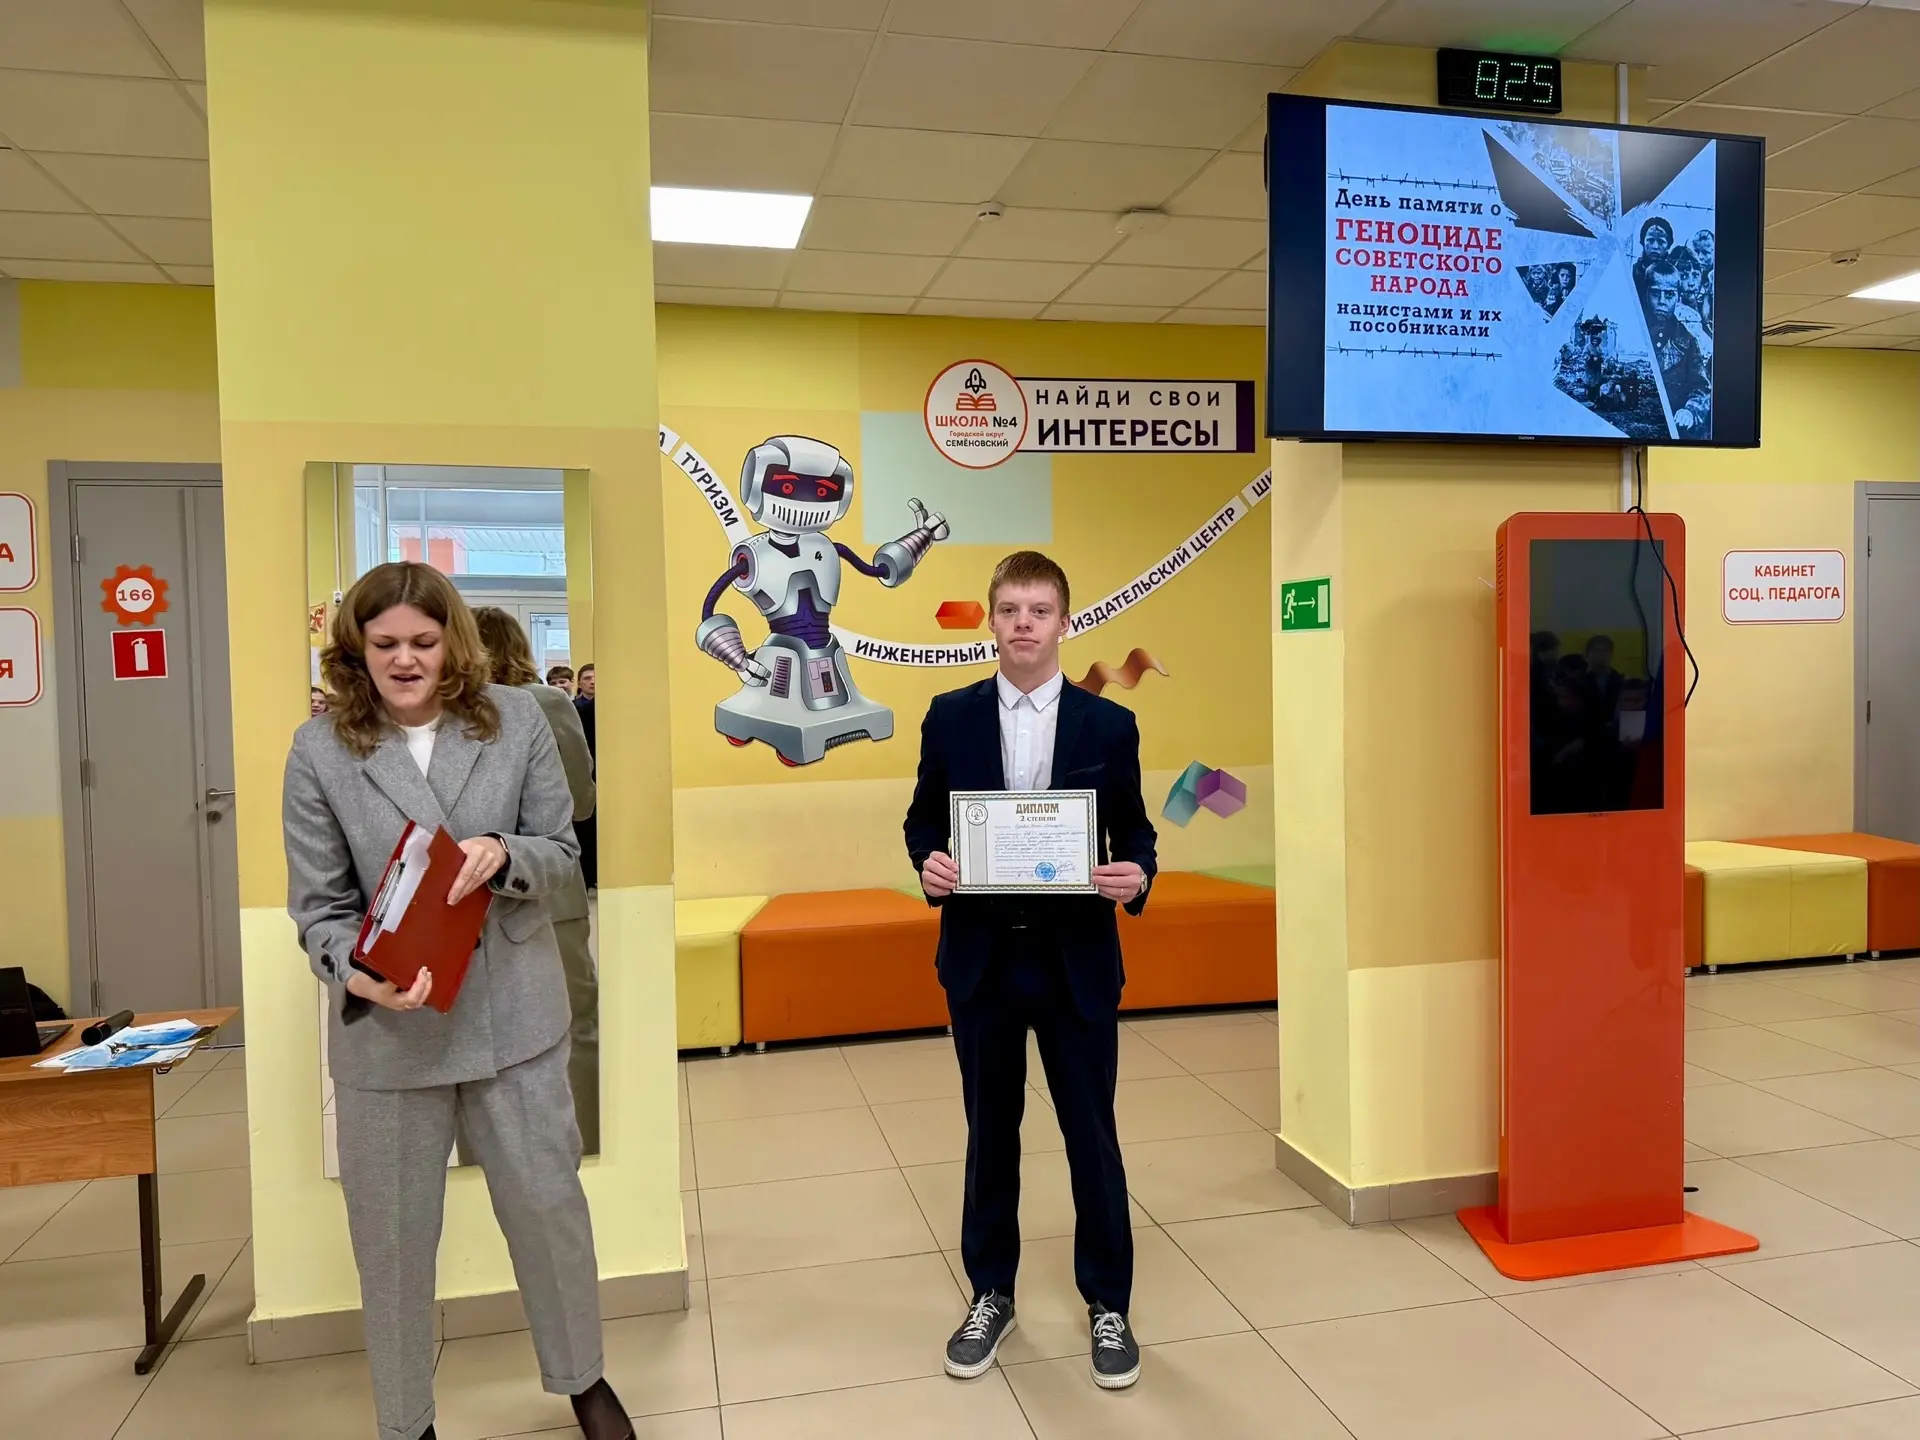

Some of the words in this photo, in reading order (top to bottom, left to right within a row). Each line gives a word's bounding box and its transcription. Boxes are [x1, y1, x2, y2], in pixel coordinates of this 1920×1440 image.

[1475, 60, 1553, 103] 825
[1335, 188, 1391, 209] День
[1398, 197, 1483, 215] памяти
[1490, 203, 1501, 216] о
[1335, 218, 1502, 253] ГЕНОЦИДЕ
[1335, 248, 1502, 274] СОВЕТСКОГО
[1370, 275, 1469, 299] НАРОДА
[1337, 303, 1453, 319] нацистами
[1460, 308, 1472, 320] и
[1479, 309, 1502, 322] их
[1349, 318, 1490, 338] пособниками
[1036, 386, 1130, 409] НАЙДИ
[1149, 390, 1220, 407] СВОИ
[935, 415, 989, 427] ШКОЛА
[992, 416, 1018, 428] №4
[1038, 419, 1219, 447] ИНТЕРЕСЫ
[945, 438, 1009, 447] СЕМЁНОВСКИЙ
[949, 430, 985, 438] Городской
[681, 452, 739, 527] ТУРИЗМ
[1071, 546, 1192, 632] ИЗДАТЕЛЬСКИЙ
[1189, 507, 1236, 553] ЦЕНТР
[1755, 565, 1816, 577] КАБИНЕТ
[118, 589, 152, 601] 166
[1728, 588, 1764, 602] СОЦ.
[1768, 587, 1841, 602] ПЕДАГОГА
[855, 639, 986, 664] ИНЖЕНЕРНЫЙ
[1015, 803, 1060, 814] ДИПЛОМ
